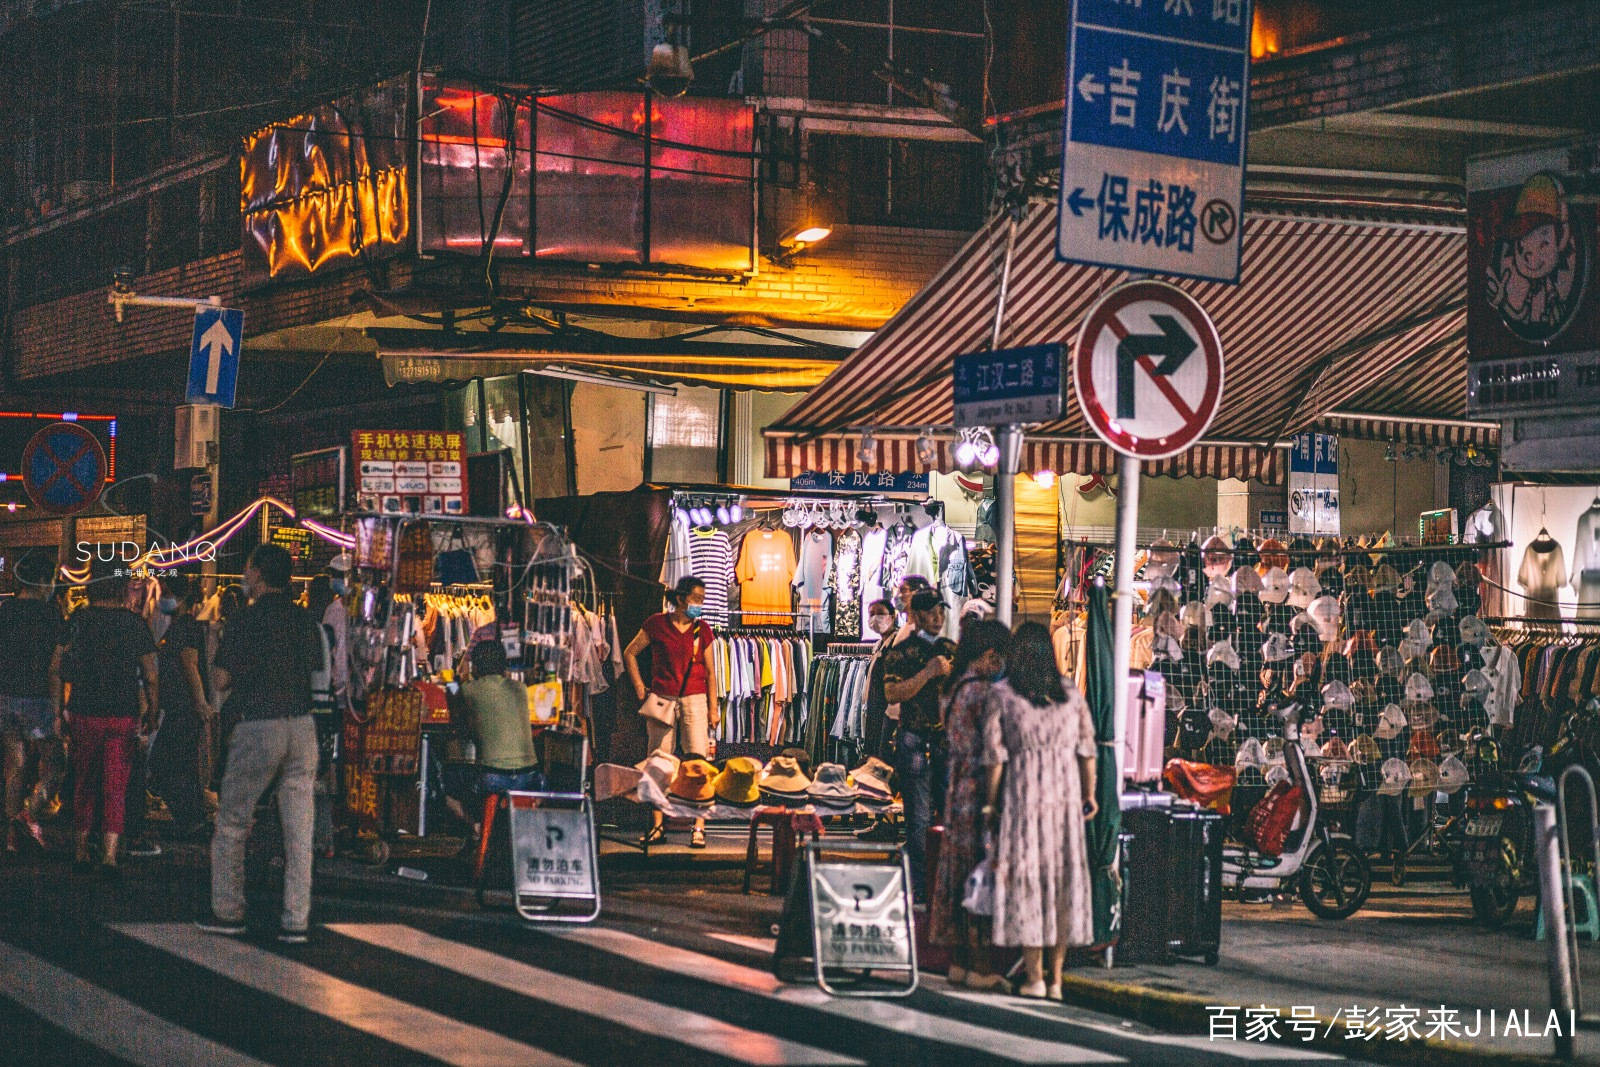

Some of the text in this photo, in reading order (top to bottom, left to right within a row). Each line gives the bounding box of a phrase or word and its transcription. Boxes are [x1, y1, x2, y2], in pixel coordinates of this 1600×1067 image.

[1108, 57, 1240, 144] 吉庆街
[1097, 172, 1198, 254] 保成路
[976, 358, 1035, 392] 江汉二路
[358, 433, 461, 449] 手机快速换屏
[1300, 432, 1337, 463] 南京路
[827, 469, 896, 488] 保成路
[906, 480, 927, 489] 234m
